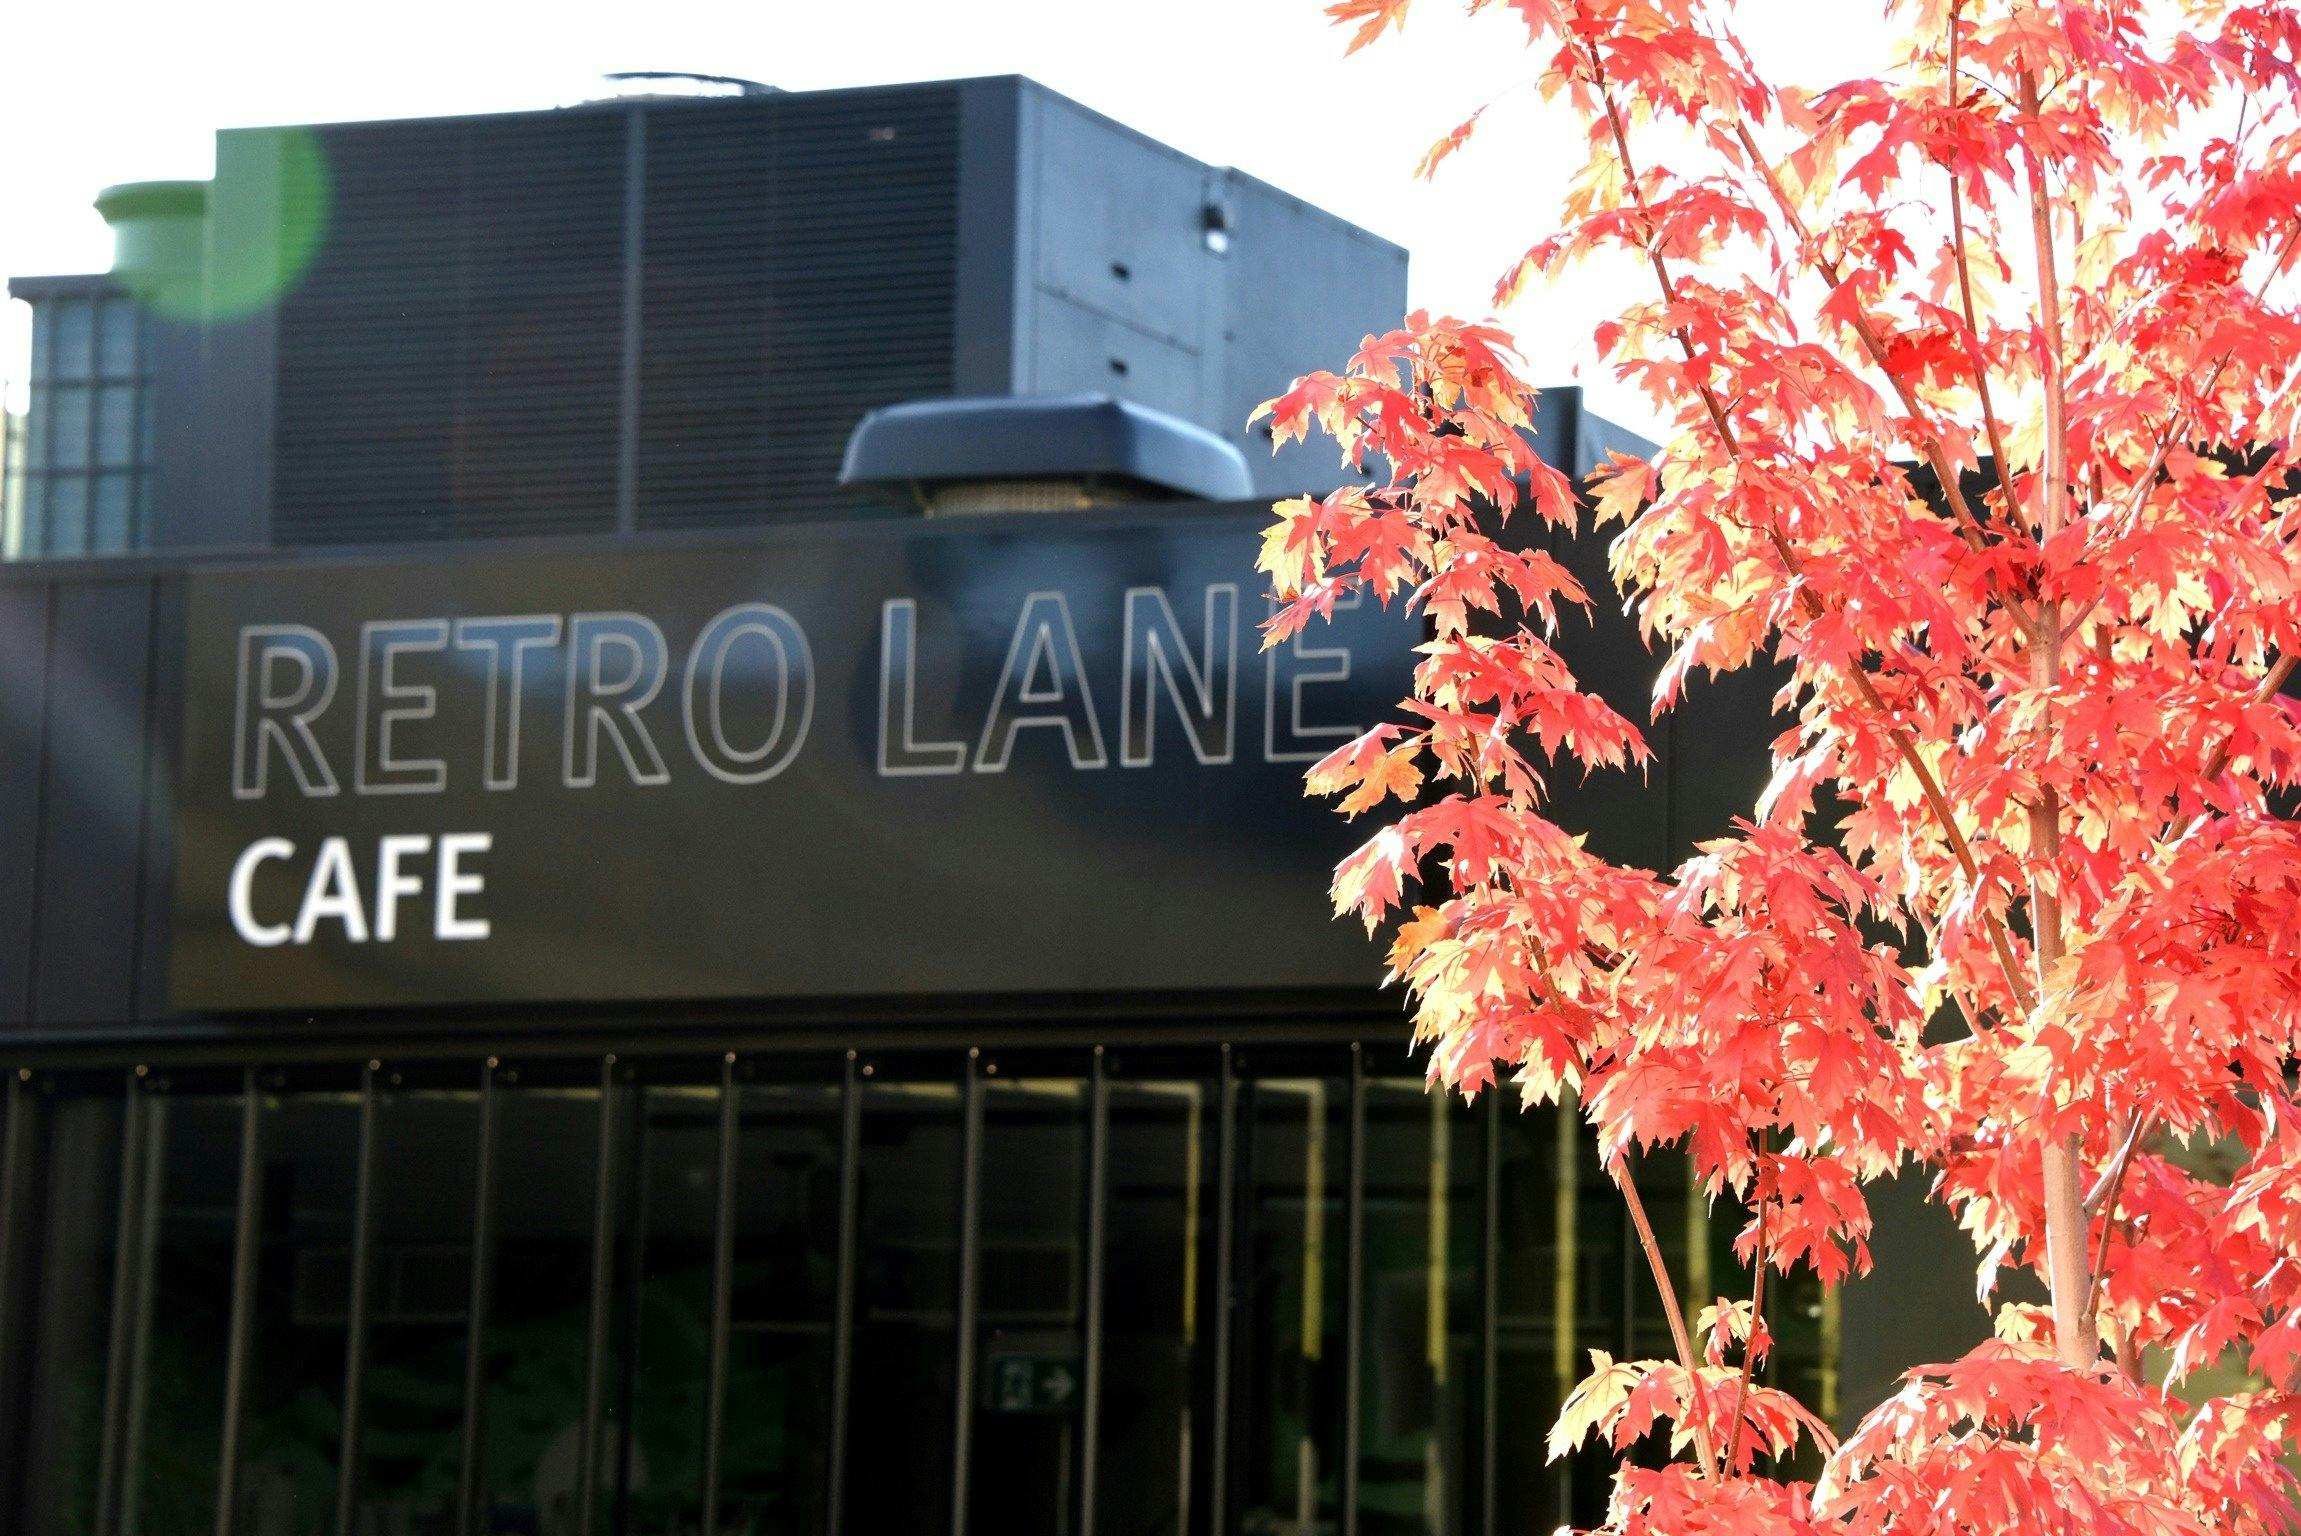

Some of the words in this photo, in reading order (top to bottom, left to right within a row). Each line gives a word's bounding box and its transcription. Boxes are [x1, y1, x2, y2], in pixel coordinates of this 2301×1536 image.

[233, 602, 815, 799] RETRO
[877, 576, 1364, 776] LANE
[228, 832, 493, 947] CAFE
